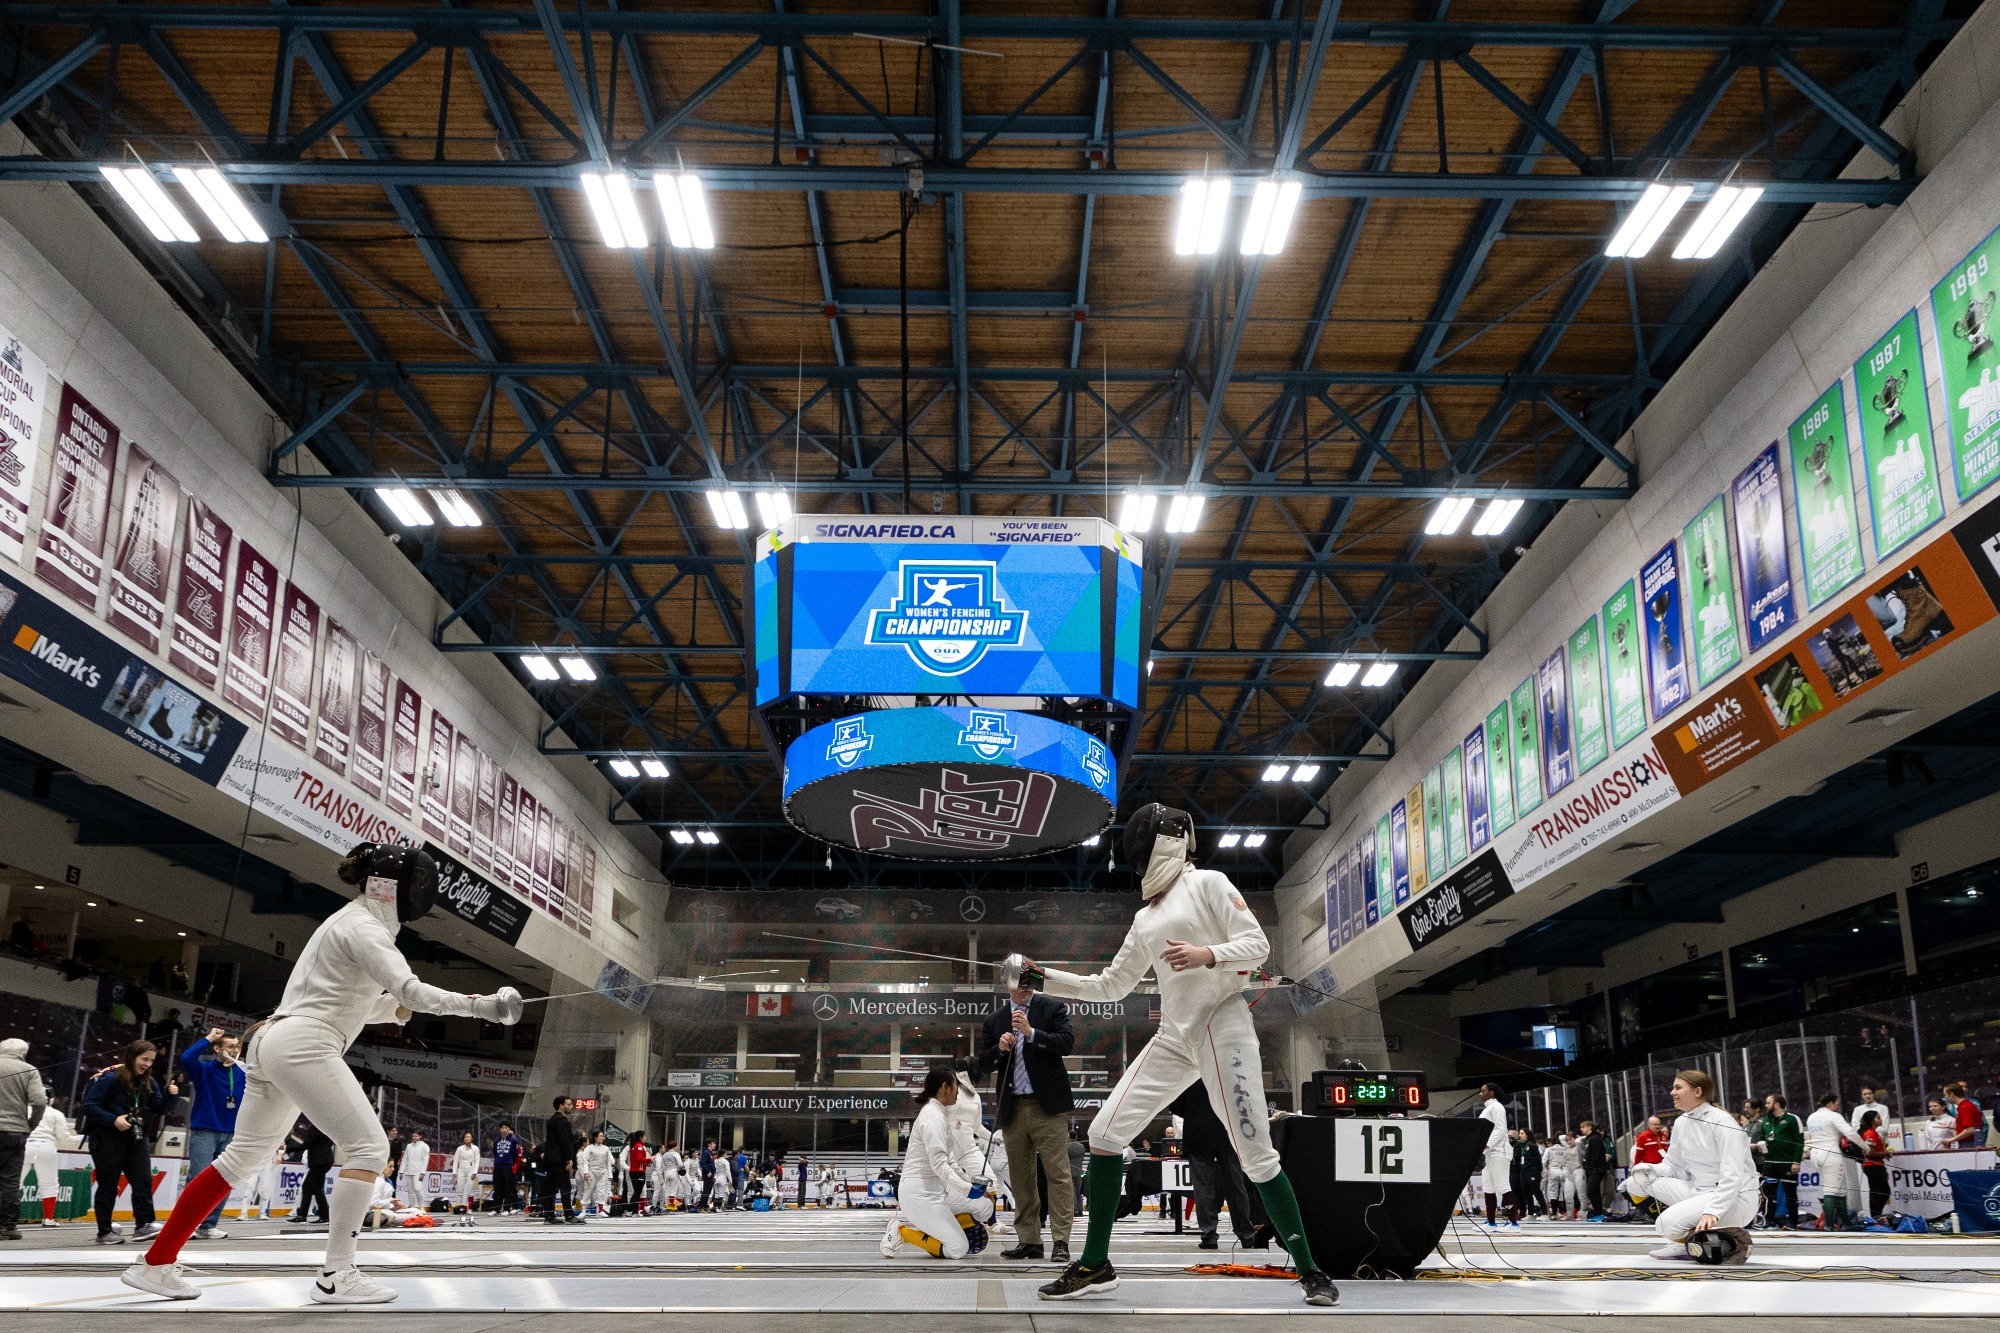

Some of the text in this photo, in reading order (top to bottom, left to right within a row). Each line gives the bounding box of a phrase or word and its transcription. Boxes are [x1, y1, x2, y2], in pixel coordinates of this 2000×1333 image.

[1950, 254, 1988, 302] 1989
[1869, 335, 1901, 377] 1987
[72, 403, 107, 443] ONTARIO
[1802, 403, 1829, 440] 1986
[70, 421, 104, 457] HOCKEY
[59, 433, 109, 483] ASSOCIATION
[1761, 462, 1774, 481] CUP
[1964, 440, 1997, 477] MINTO
[57, 450, 107, 500] CHAMPIONS
[203, 517, 216, 538] OHL
[1002, 522, 1068, 531] YOU'VE BEEN
[1693, 511, 1715, 540] 1983
[1882, 489, 1934, 538] MINTO CUP
[195, 526, 221, 558] LEYDEN
[814, 523, 956, 539] SIGNAFIED.CA
[46, 537, 95, 579] 1980
[192, 540, 221, 573] DIVISION
[1662, 556, 1673, 572] CUP
[1812, 547, 1857, 590] MINTO CUP
[185, 553, 223, 593] CHAMPIONS
[1644, 567, 1676, 603] CHAMPIONS
[117, 587, 157, 622] 1985
[236, 595, 270, 630] CHAMPIONS
[905, 607, 991, 618] WOMEN'S FENCING
[1611, 594, 1627, 618] 1982
[885, 617, 1013, 637] CHAMPIONSHIP
[1759, 607, 1784, 637] 1984
[177, 629, 215, 662] 1986
[30, 634, 101, 689] Mark's
[230, 667, 263, 695] 1988
[1660, 684, 1680, 709] 1982
[277, 699, 306, 724] 1989
[1688, 698, 1742, 739] Mark's
[125, 727, 143, 742] More
[319, 729, 345, 752] 1989
[965, 734, 1012, 745] CHAMPIONSHIP
[232, 754, 301, 783] Peterborough
[356, 755, 380, 776] 1992
[390, 778, 412, 798] 1993
[222, 774, 243, 793] Proud
[243, 786, 276, 811] supporter
[291, 813, 324, 836] community
[1627, 807, 1639, 819] 400
[1504, 830, 1536, 873] Peterborough
[1511, 875, 1523, 887] Proud
[1523, 862, 1544, 880] supporter
[1549, 853, 1558, 865] our
[1556, 841, 1582, 862] community
[70, 870, 77, 881] 5
[1912, 864, 1929, 881] C6
[448, 870, 491, 915] Eighty
[1411, 884, 1461, 942] One Eighty
[849, 997, 990, 1015] Mercedes-Benz
[207, 1014, 248, 1031] RICART
[382, 1056, 438, 1070] 705.748.9955
[483, 1067, 524, 1079] RICART
[707, 1057, 729, 1065] SRP
[575, 1099, 595, 1109] 9:48
[672, 1094, 888, 1112] Your Local Luxury Experience
[1335, 1085, 1420, 1105] 0 2:23 0
[1361, 1125, 1403, 1175] 12
[1173, 1164, 1193, 1187] 10
[1894, 1190, 1924, 1203] Digital
